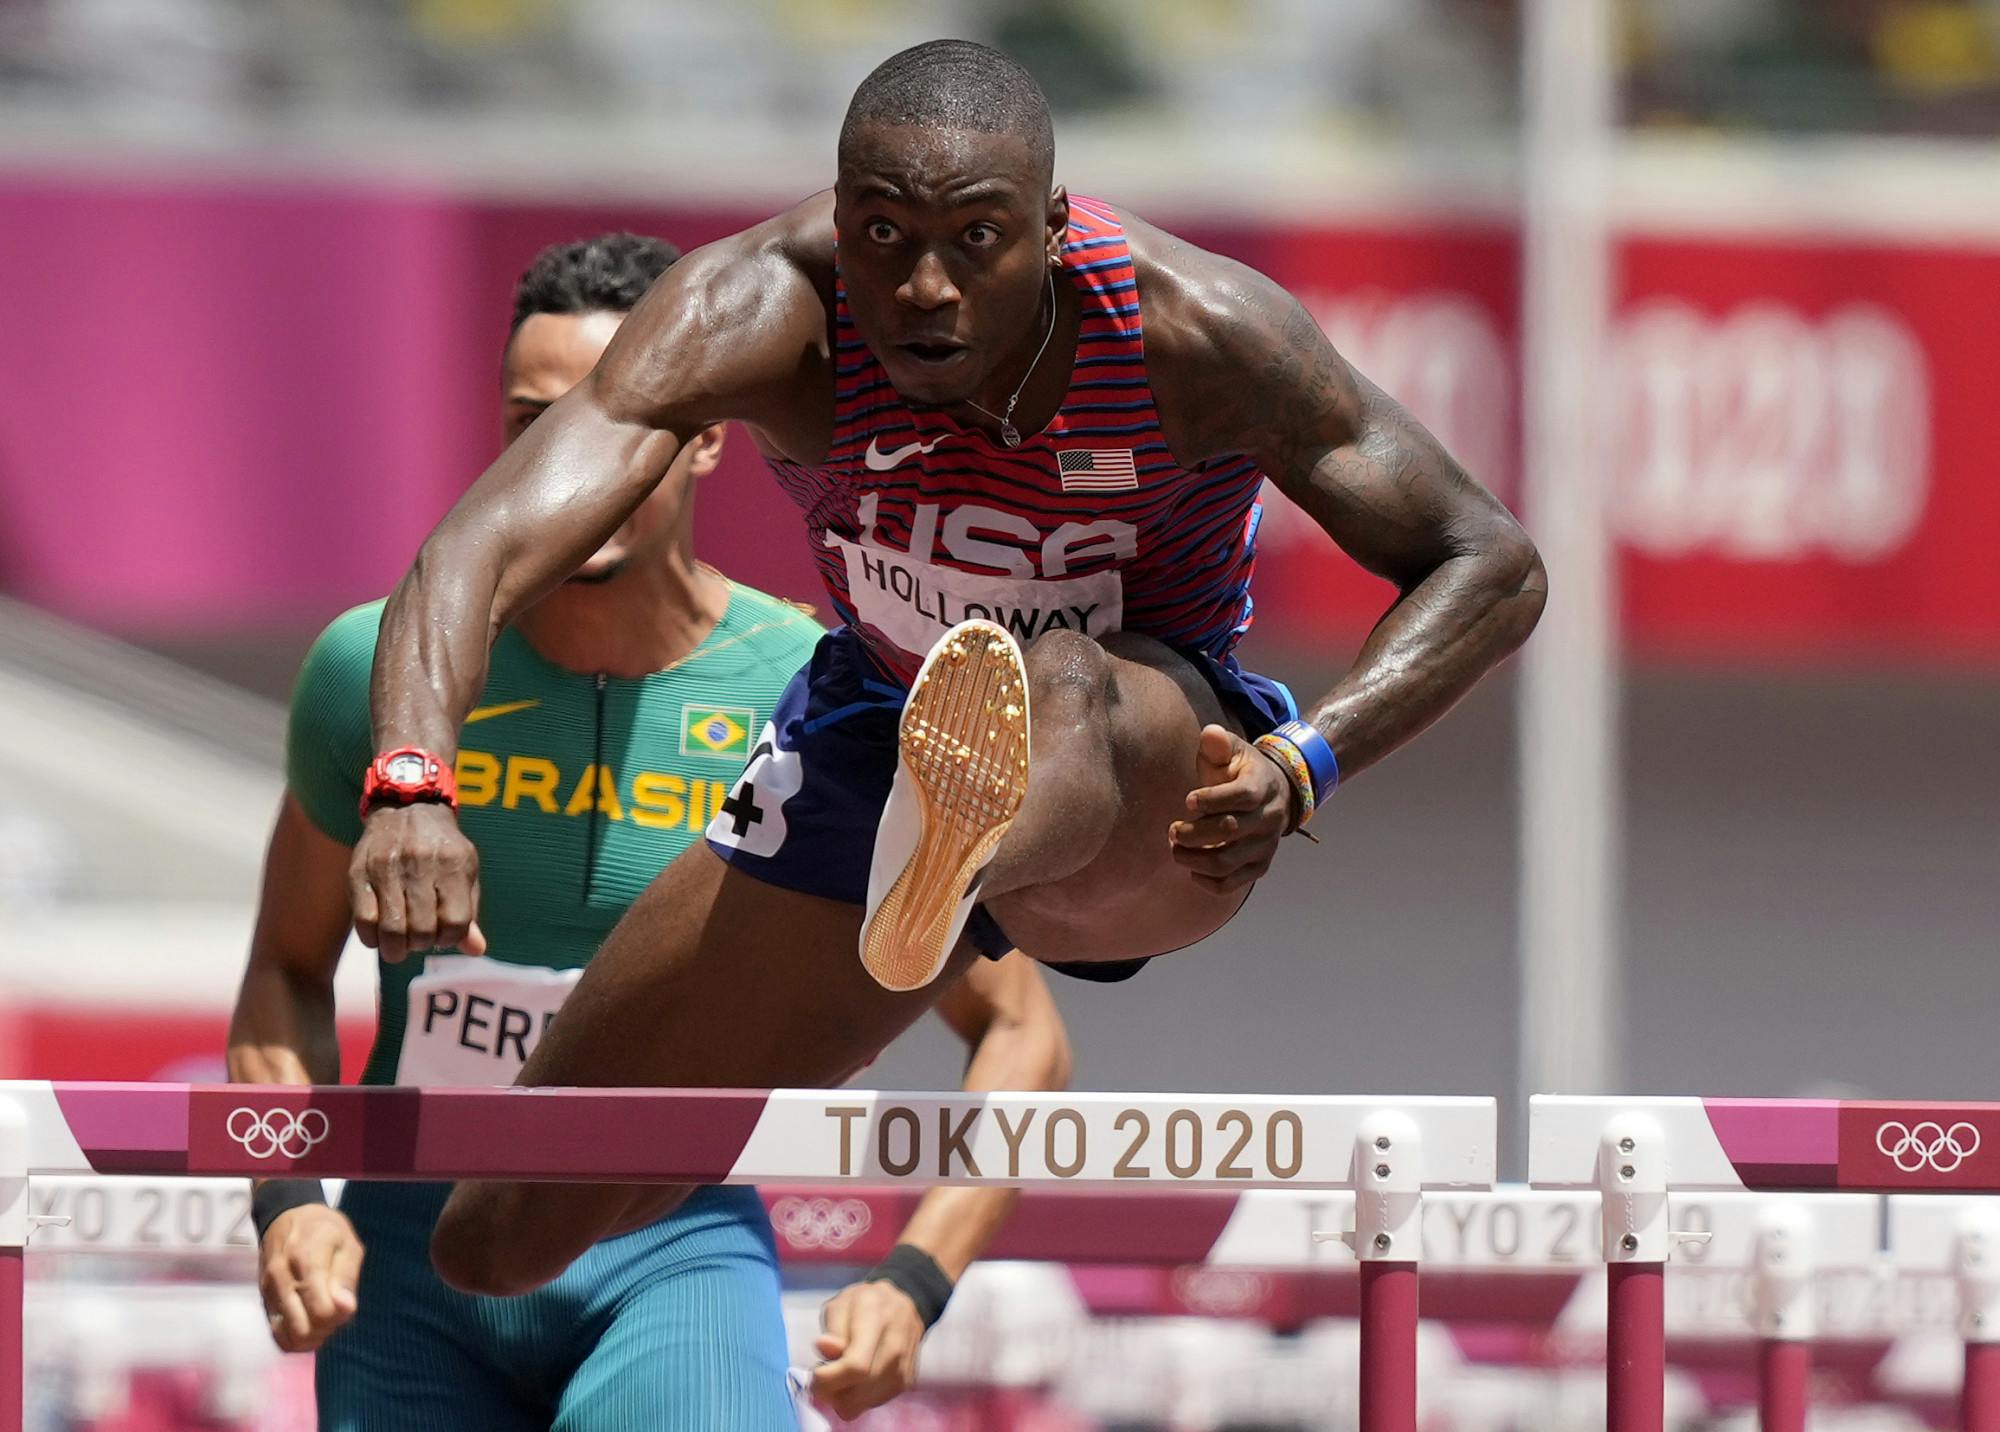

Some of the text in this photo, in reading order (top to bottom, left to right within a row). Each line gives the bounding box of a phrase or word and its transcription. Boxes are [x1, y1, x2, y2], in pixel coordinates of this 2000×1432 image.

[857, 492, 1138, 579] USA
[424, 990, 555, 1062] PER
[825, 1107, 1303, 1179] TOKYO 2020
[1301, 1201, 1521, 1257] TYO
[1548, 1202, 1712, 1264] 20
